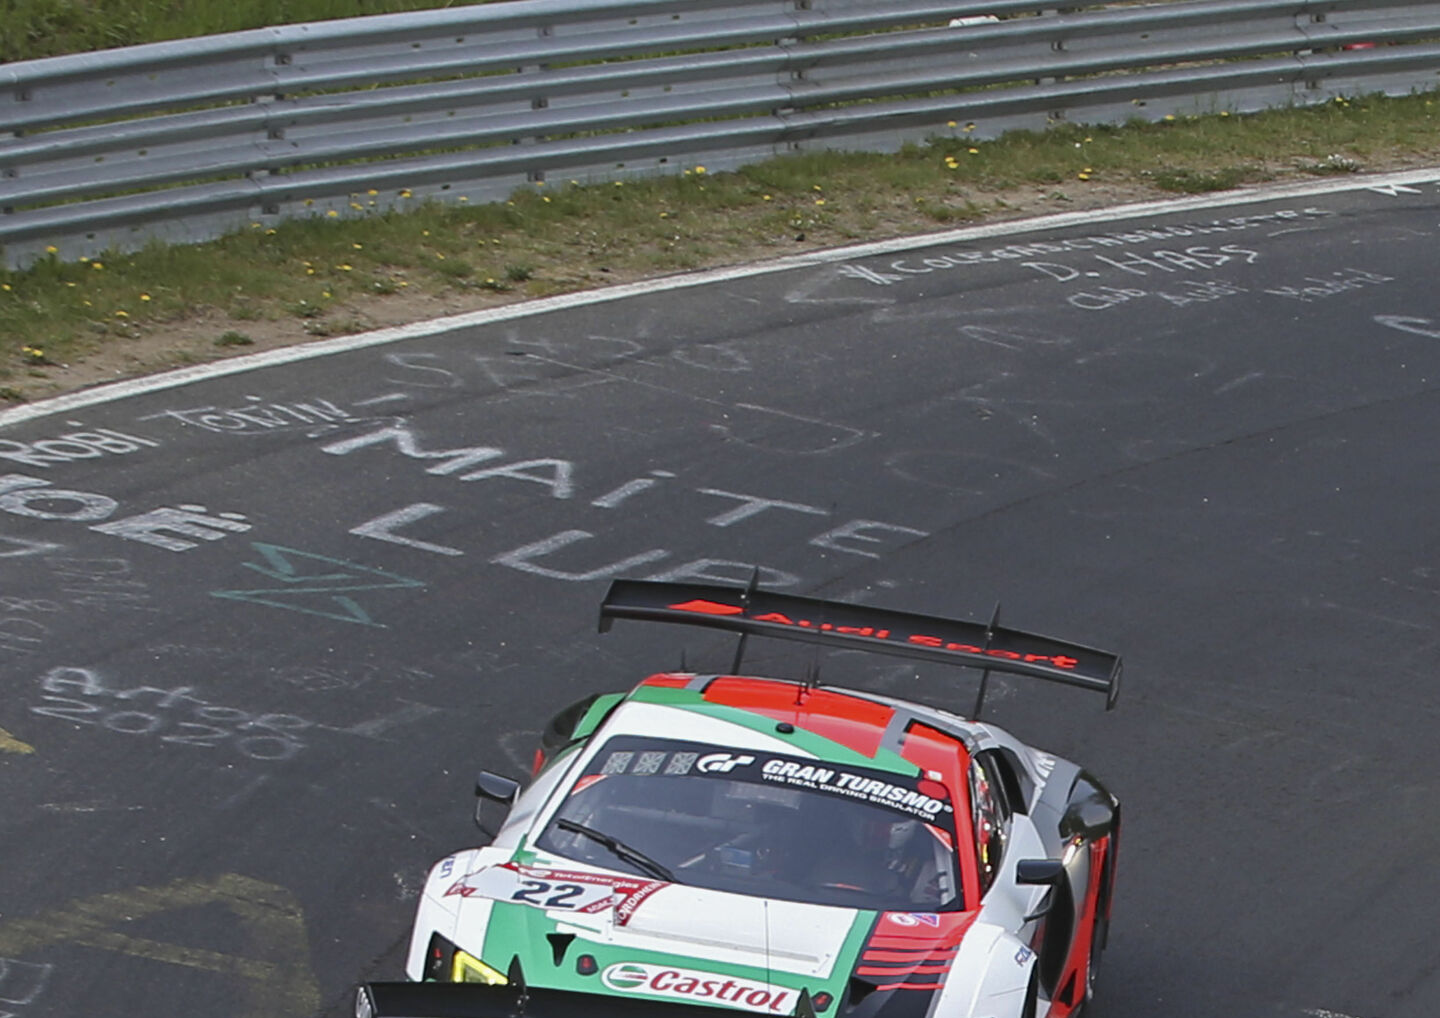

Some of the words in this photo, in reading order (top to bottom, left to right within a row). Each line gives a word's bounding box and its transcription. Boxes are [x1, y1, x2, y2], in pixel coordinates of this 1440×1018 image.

[762, 759, 835, 785] GRAN
[762, 773, 785, 783] THE
[786, 776, 818, 790] REAL
[868, 795, 937, 821] SIMULATOR
[511, 879, 586, 909] 22
[649, 969, 791, 1013] Castrol
